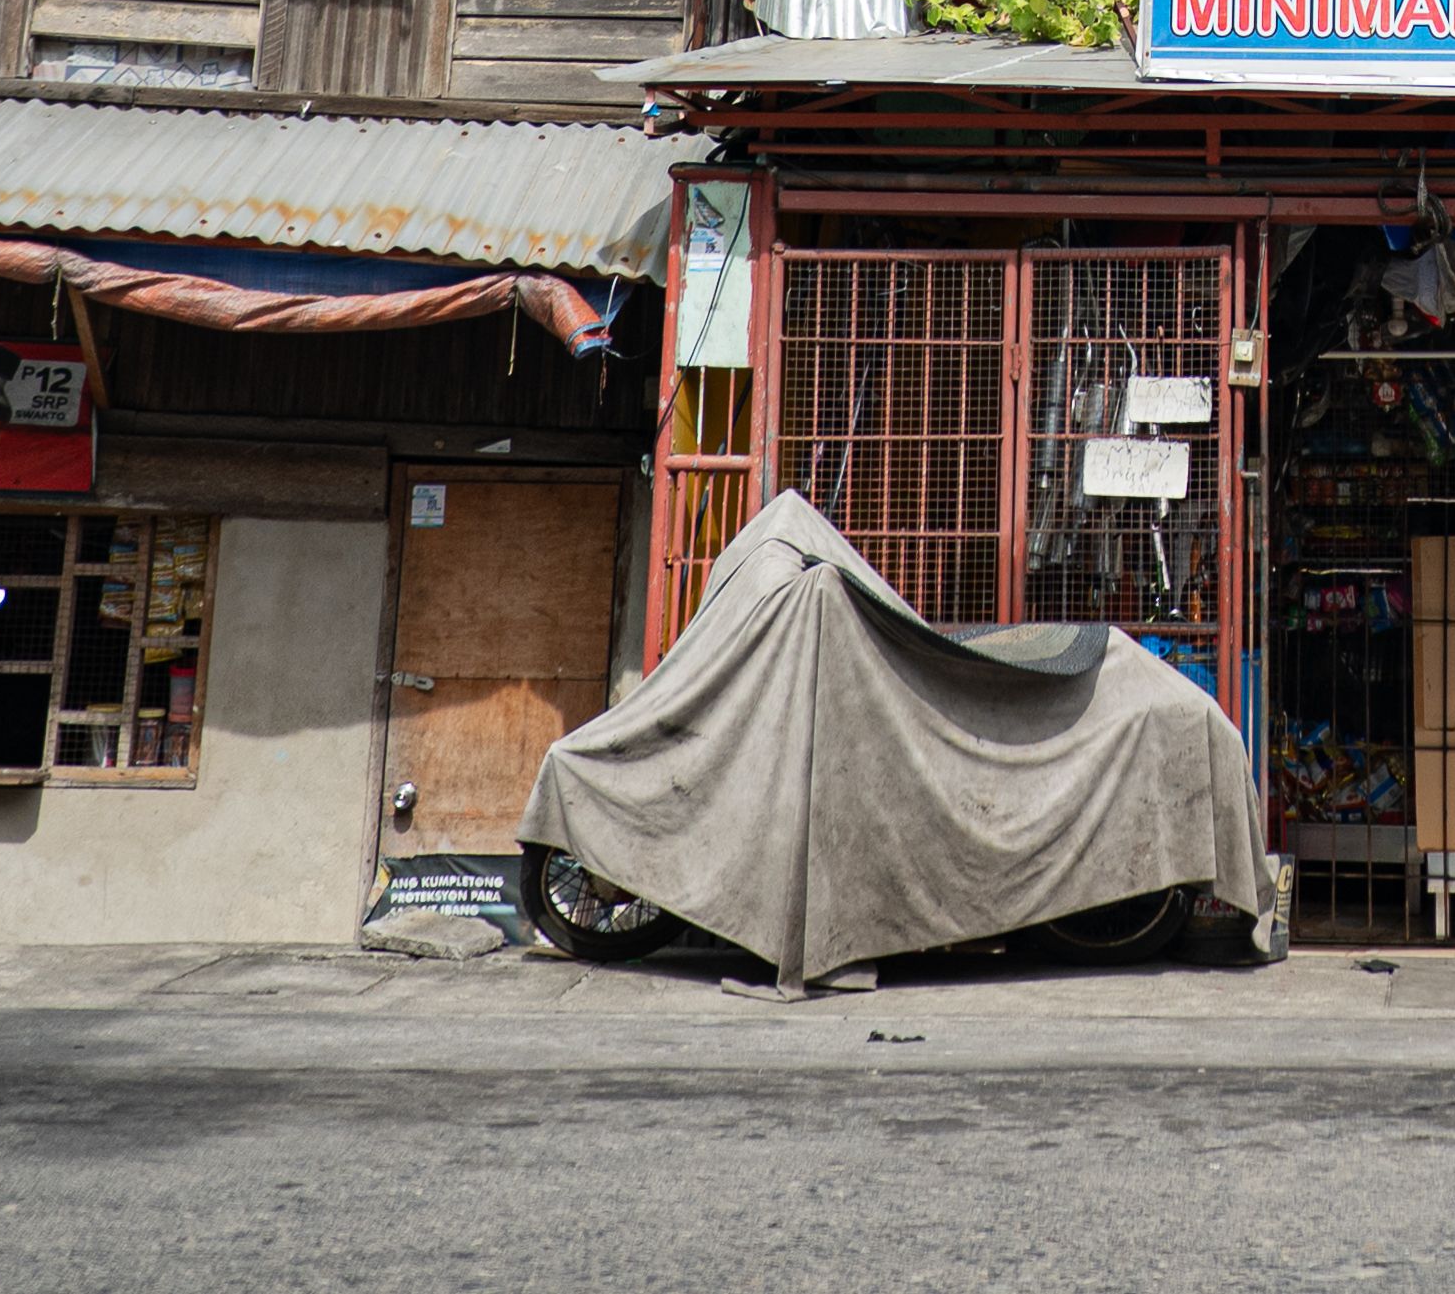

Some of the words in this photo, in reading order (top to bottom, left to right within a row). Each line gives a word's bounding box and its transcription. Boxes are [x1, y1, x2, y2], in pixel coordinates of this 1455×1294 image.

[32, 395, 68, 409] SRP
[391, 877, 418, 890] ANG
[421, 875, 504, 889] KUMPLETONG
[391, 890, 467, 903] PROTEKSYON
[471, 890, 501, 902] PARA
